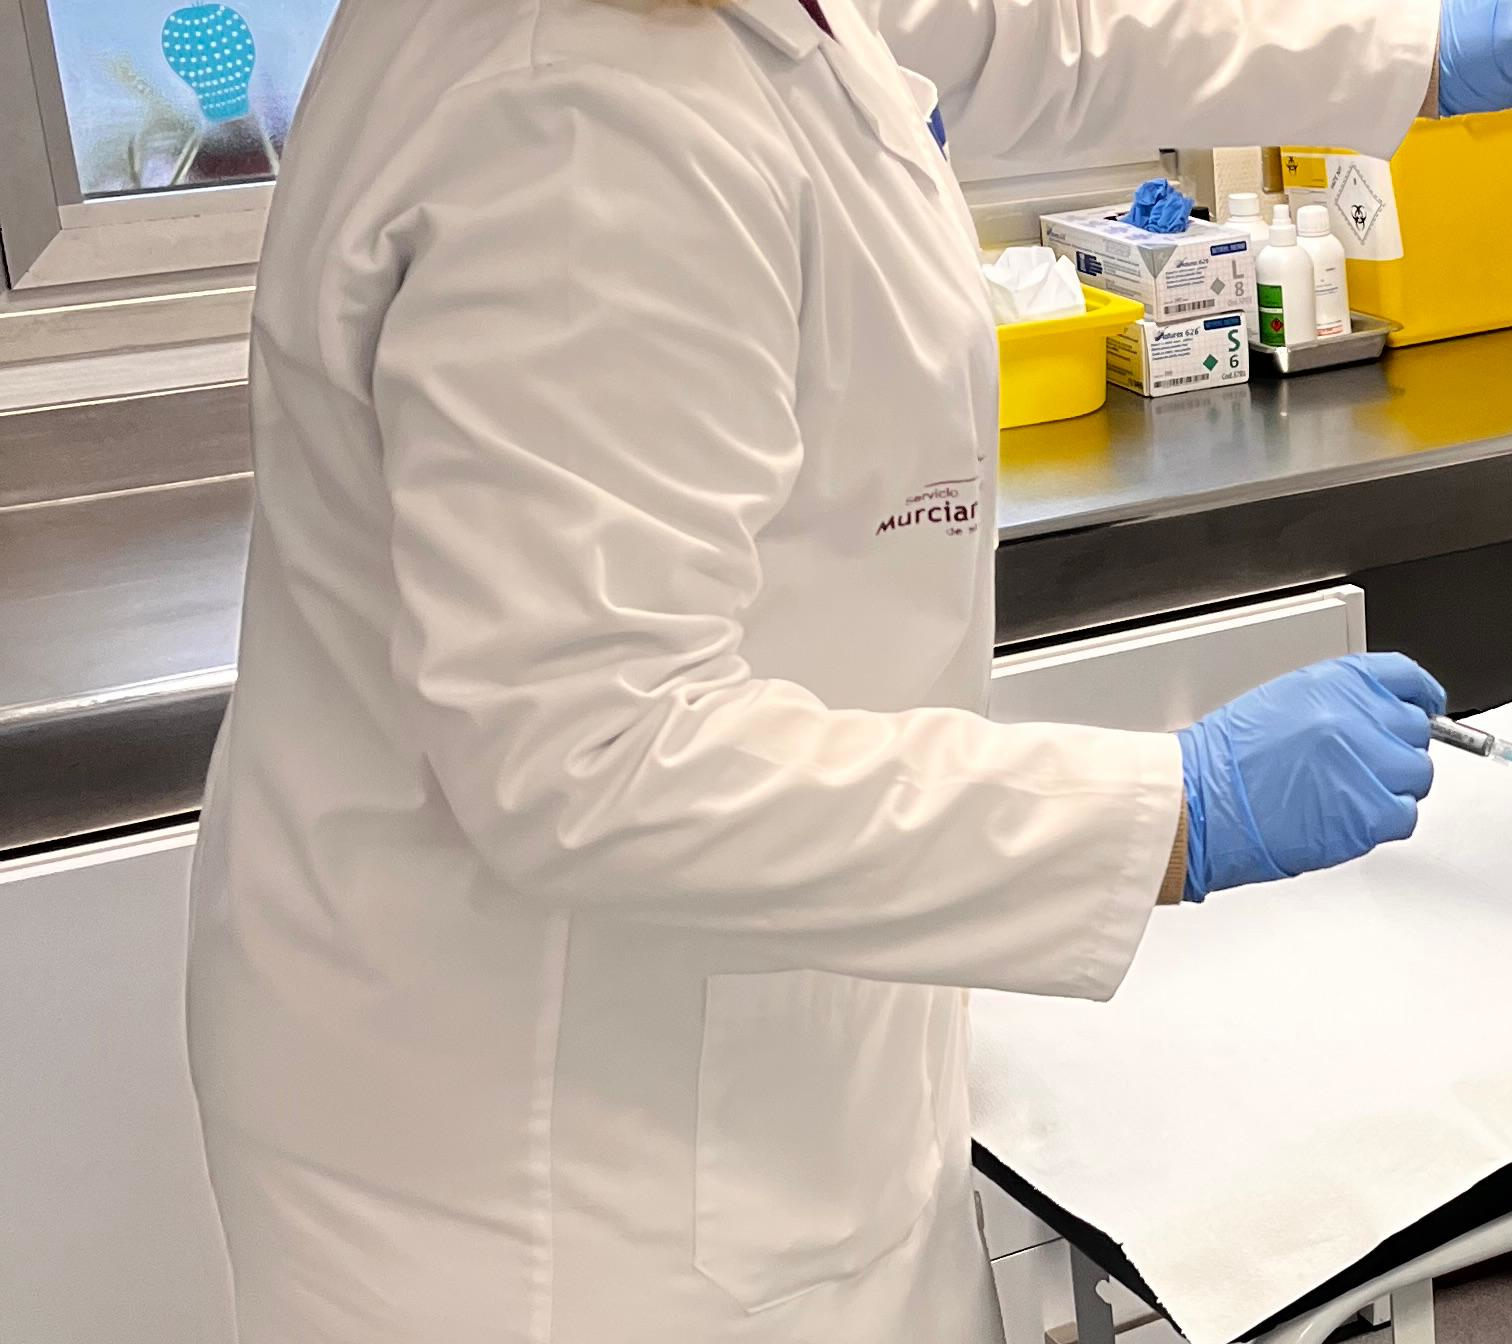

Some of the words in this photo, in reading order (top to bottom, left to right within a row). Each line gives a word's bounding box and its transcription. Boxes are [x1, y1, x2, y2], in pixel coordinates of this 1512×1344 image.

[1232, 259, 1244, 280] L
[1235, 281, 1244, 296] 8
[1227, 329, 1240, 352] S
[1230, 354, 1239, 368] 6
